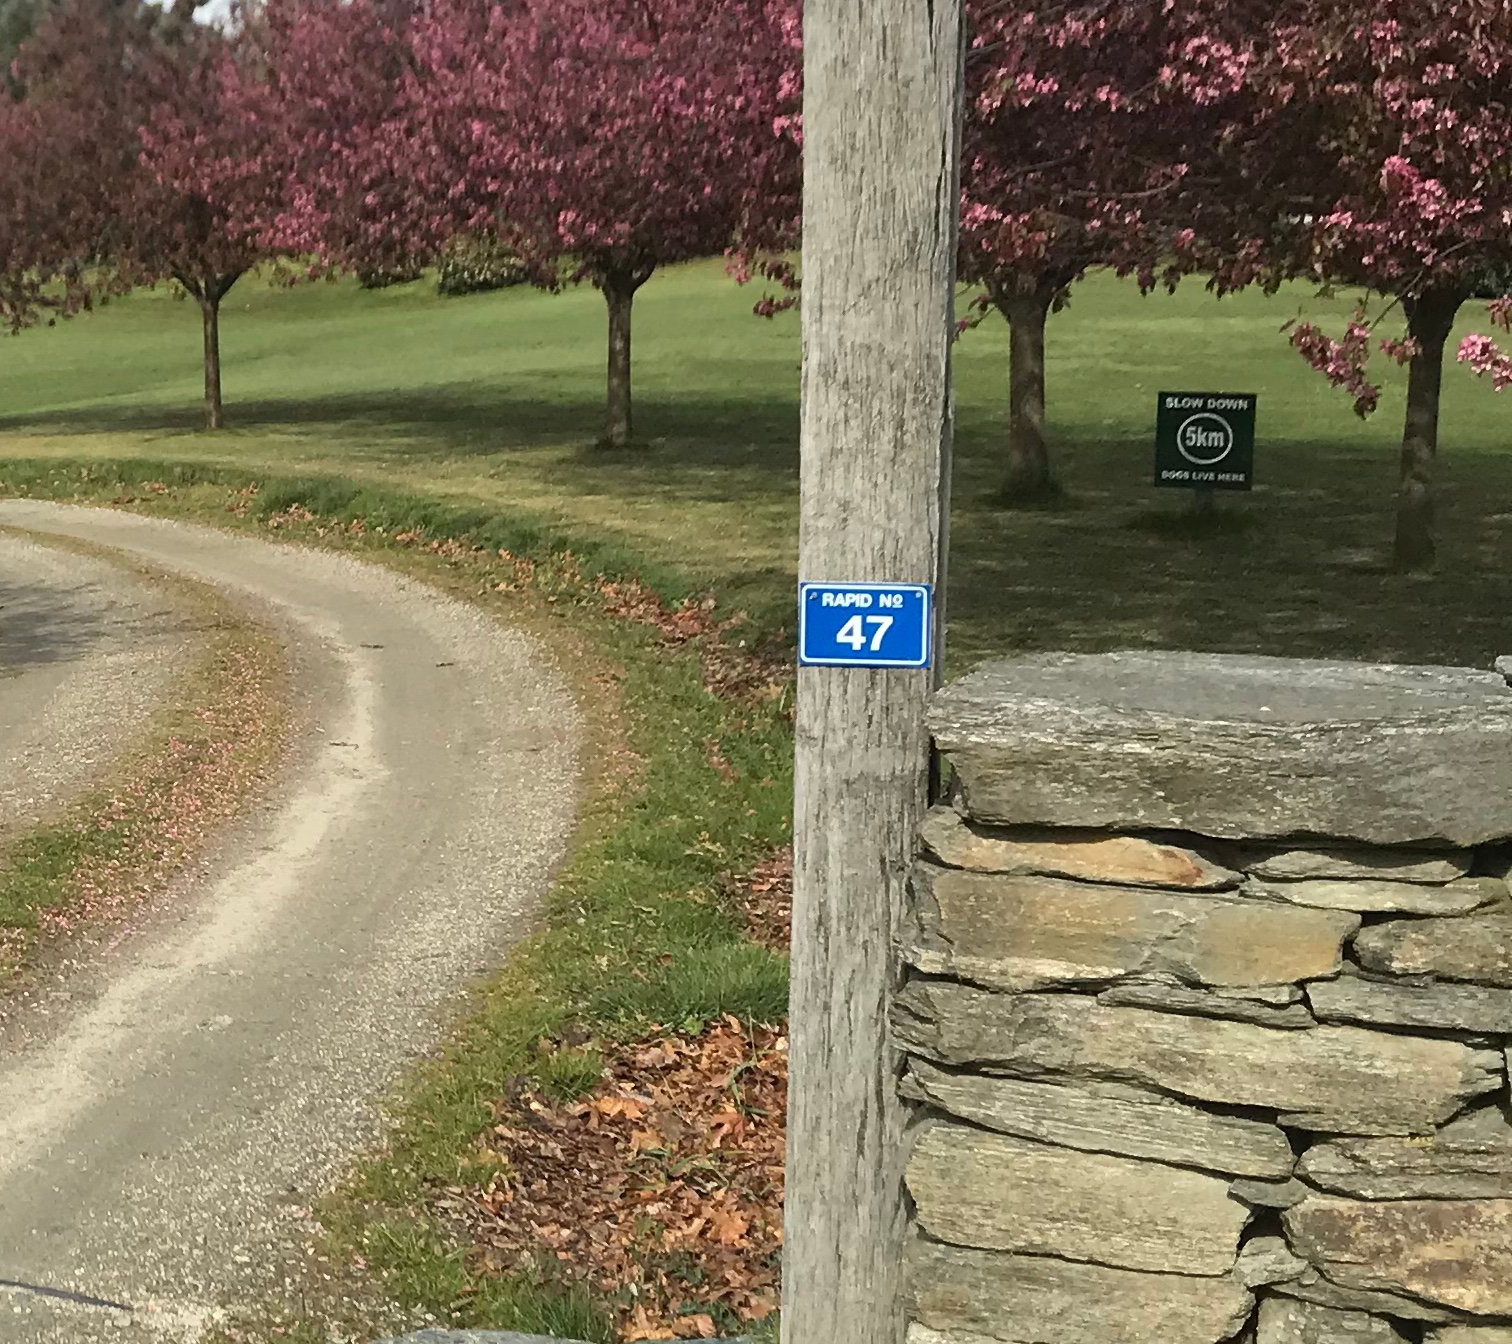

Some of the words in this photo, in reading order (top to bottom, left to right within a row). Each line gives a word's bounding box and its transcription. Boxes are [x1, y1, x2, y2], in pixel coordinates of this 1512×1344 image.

[1165, 397, 1204, 409] SLOW
[1207, 398, 1248, 410] DOWN
[1185, 426, 1225, 447] 5km
[1161, 470, 1190, 480] DOGS
[1192, 471, 1215, 481] LIVE
[1217, 472, 1246, 482] HERE
[822, 592, 872, 608] RAPID
[836, 615, 894, 651] 47
